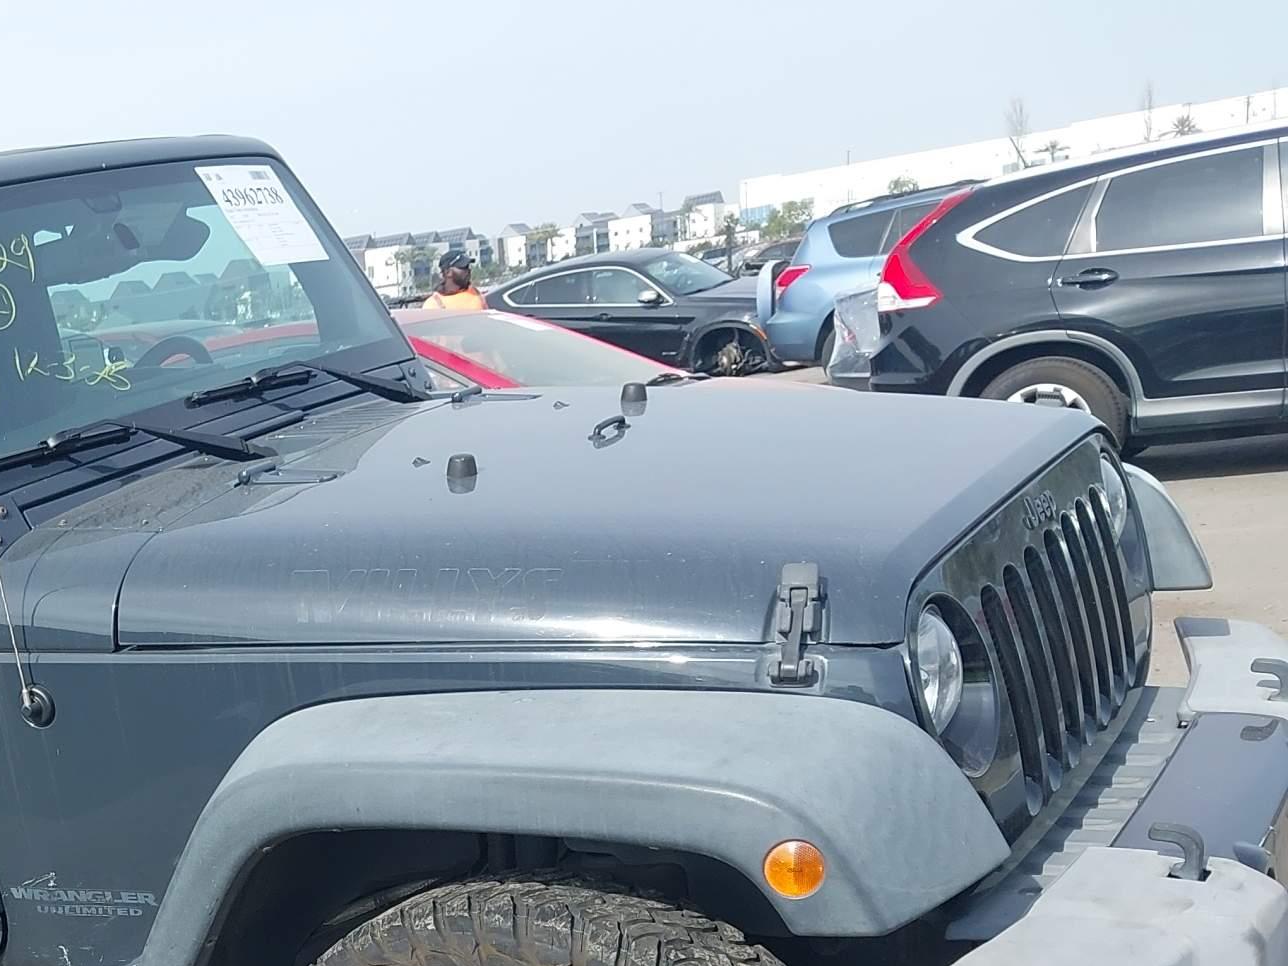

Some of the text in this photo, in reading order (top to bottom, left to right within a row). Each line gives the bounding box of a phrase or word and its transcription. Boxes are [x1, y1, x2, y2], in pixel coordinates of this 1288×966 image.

[222, 187, 284, 207] 43962738
[1023, 490, 1057, 530] Jeep
[10, 887, 158, 906] WRANGLER
